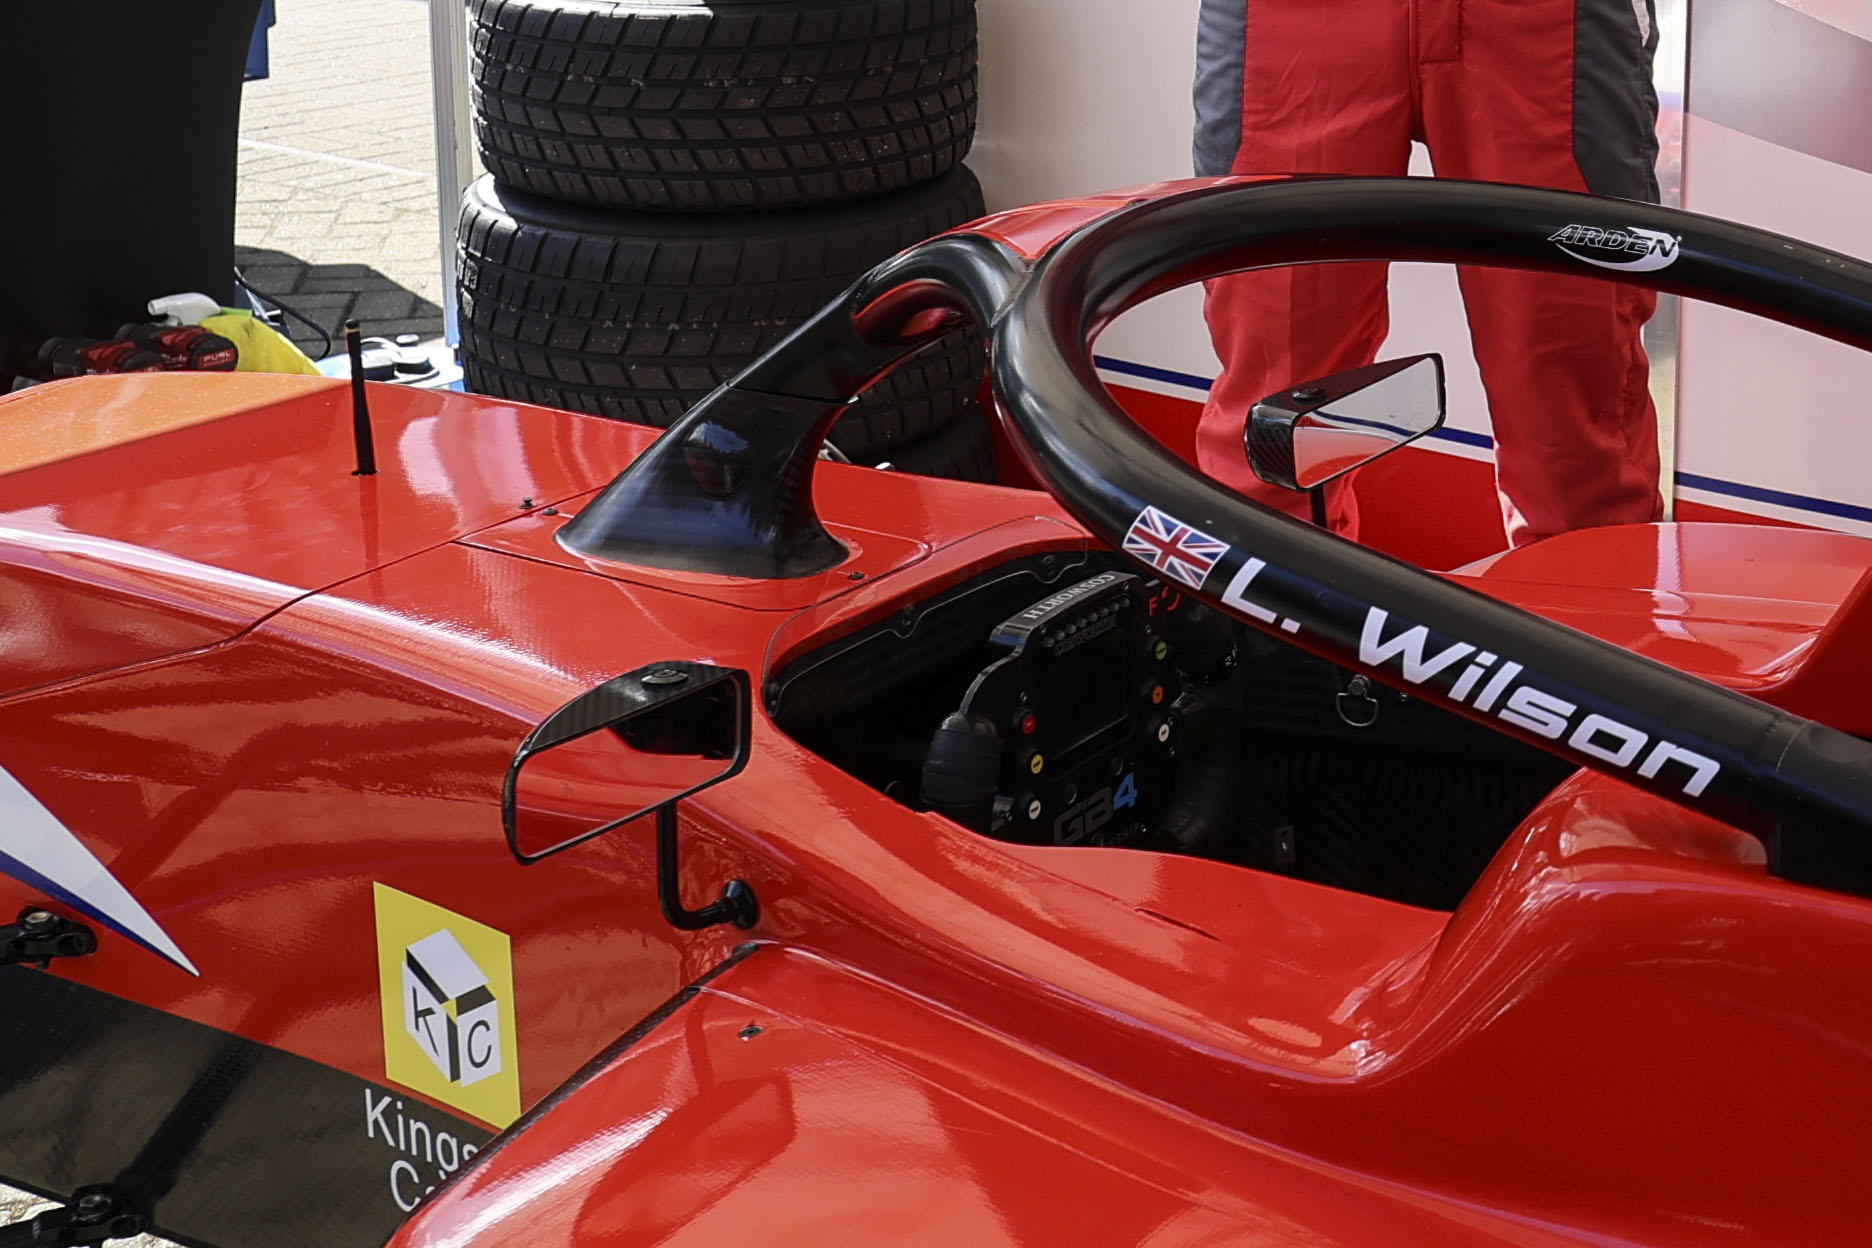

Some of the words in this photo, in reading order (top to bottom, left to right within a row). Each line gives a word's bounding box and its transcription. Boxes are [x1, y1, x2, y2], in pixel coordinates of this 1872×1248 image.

[1547, 223, 1677, 258] ARDEN
[1023, 573, 1116, 620] COSWORTH
[1221, 557, 1301, 634] L.
[1358, 606, 1721, 798] Wilson
[1053, 772, 1138, 846] GB4
